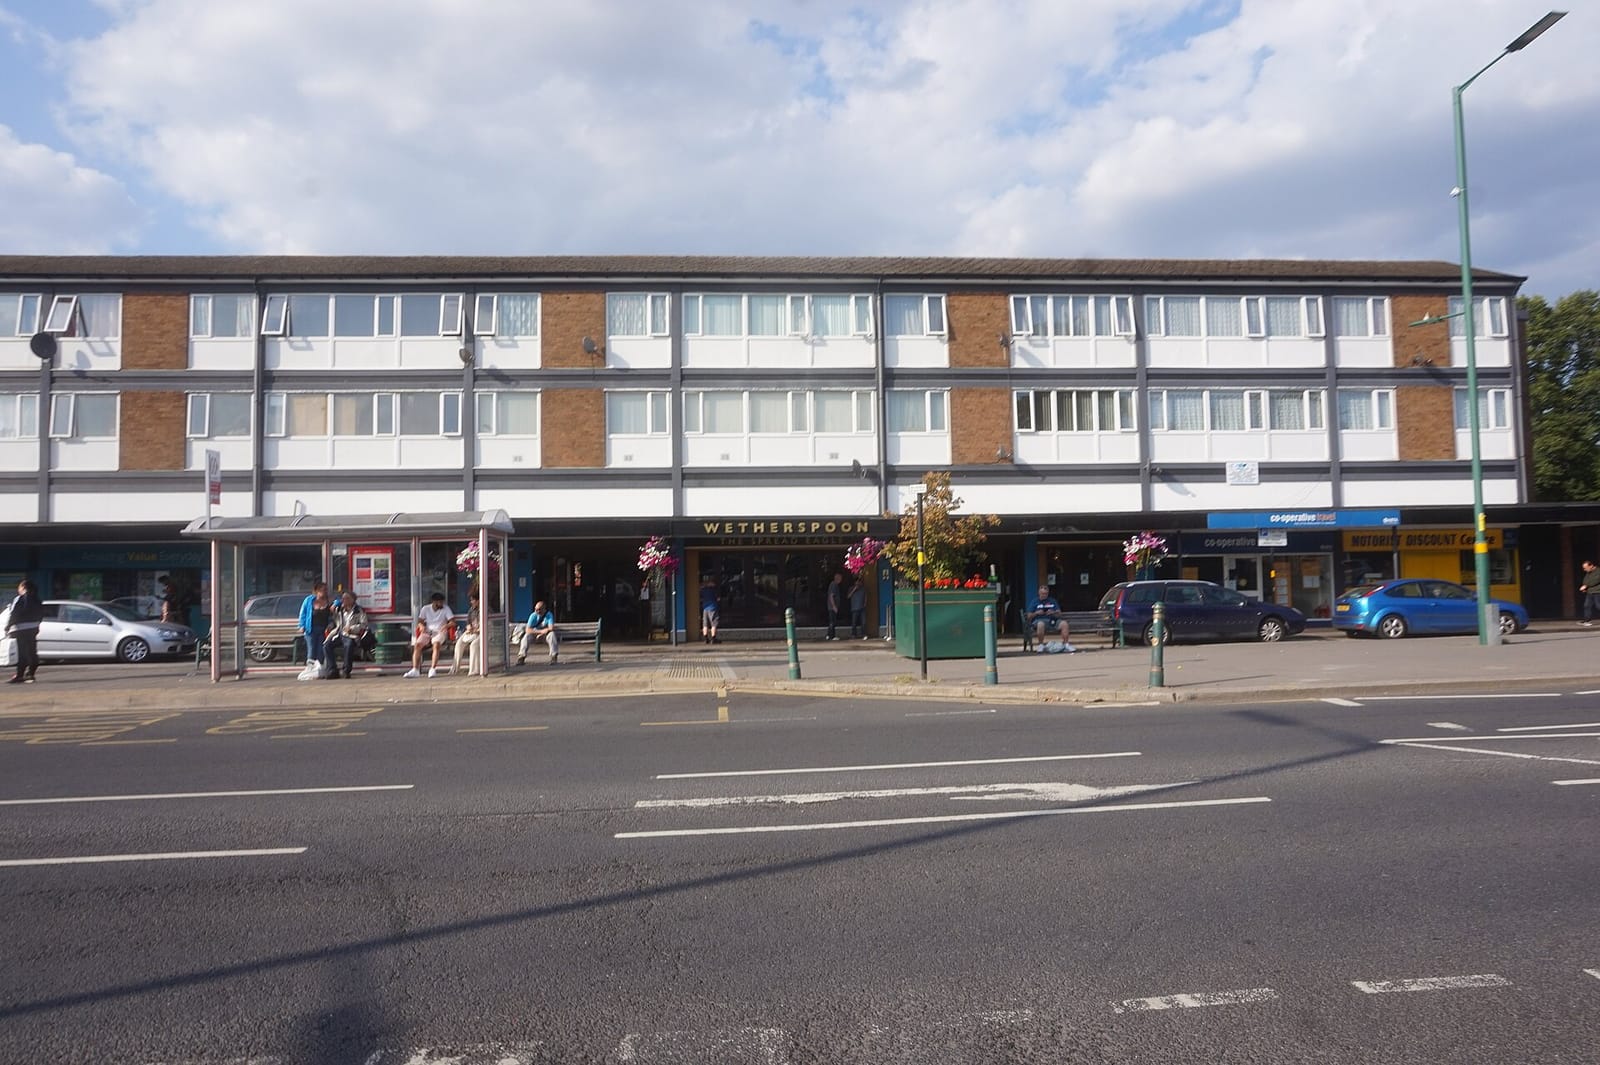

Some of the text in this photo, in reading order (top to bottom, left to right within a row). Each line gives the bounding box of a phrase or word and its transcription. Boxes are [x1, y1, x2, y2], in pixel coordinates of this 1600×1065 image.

[1270, 513, 1316, 524] co-operative
[703, 521, 869, 534] WETHERSPOON
[721, 536, 844, 545] THE SPREAD EAGLE
[1350, 535, 1402, 546] MOTORIT
[1406, 534, 1457, 546] DISCOUNT
[127, 551, 158, 561] Value
